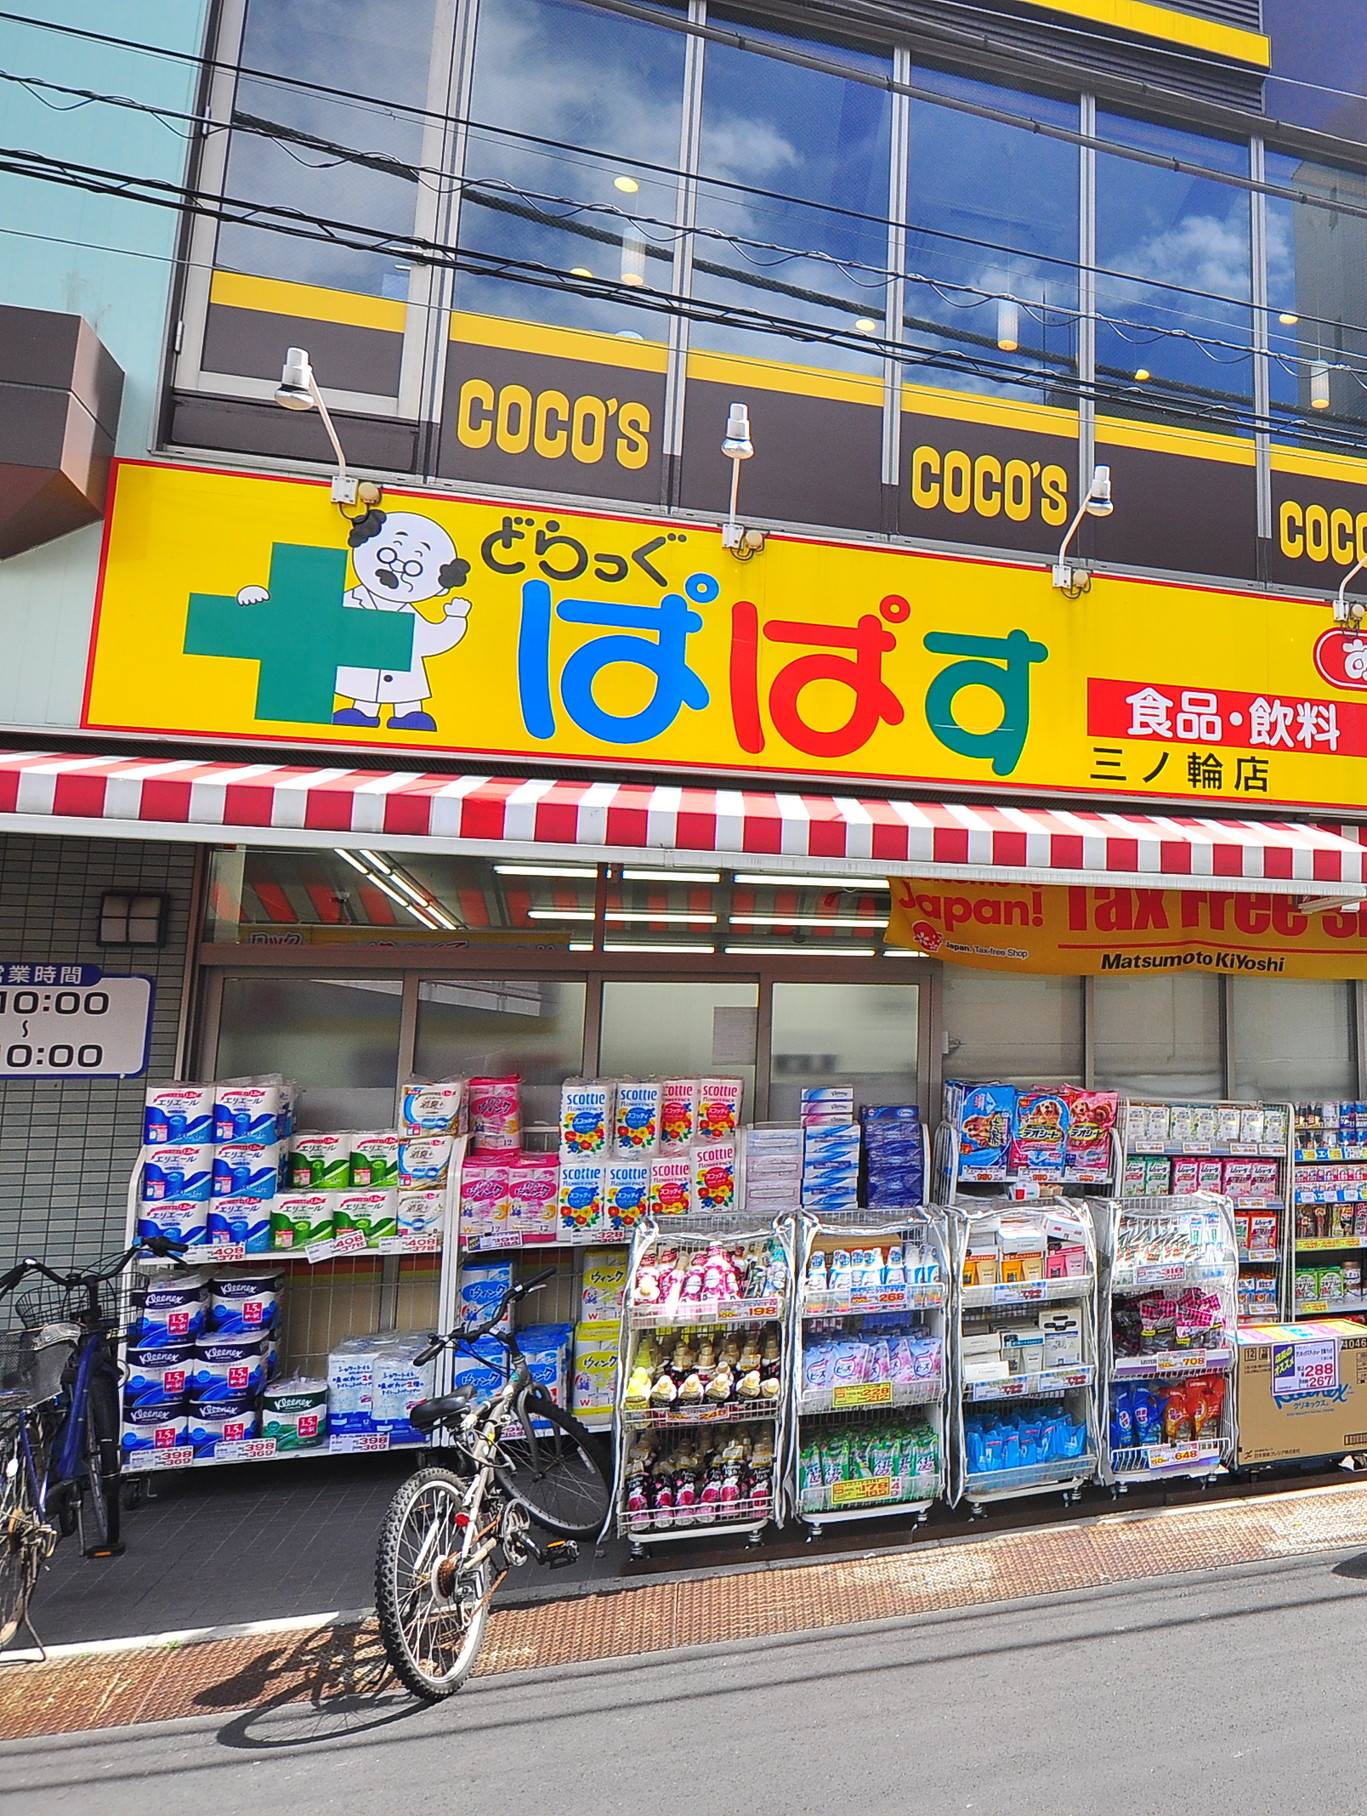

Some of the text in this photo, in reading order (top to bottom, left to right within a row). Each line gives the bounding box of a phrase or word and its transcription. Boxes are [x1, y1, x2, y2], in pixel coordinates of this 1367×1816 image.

[457, 379, 650, 469] COCO'S
[912, 446, 1067, 526] COCO'S
[481, 517, 687, 587] どらっぐ
[518, 573, 1049, 776] ぱぱす
[1125, 687, 1340, 752] 食品・飲料
[1090, 747, 1270, 792] 三ノ輪店
[898, 880, 1044, 932] Japan!
[0, 965, 83, 984] 業時間
[621, 1089, 658, 1101] scottie
[703, 1085, 738, 1097] scottie
[567, 1093, 606, 1105] scottie
[697, 1148, 733, 1162] scottie
[562, 1168, 600, 1180] scottie
[610, 1168, 648, 1180] scottie
[653, 1164, 689, 1176] scottie
[220, 1284, 258, 1295] Kleenex
[145, 1293, 184, 1306] Kleenex
[879, 1293, 905, 1302] 268
[749, 1307, 777, 1316] 198
[139, 1352, 179, 1365] Kleenex
[205, 1347, 243, 1360] Kleenex
[1246, 1349, 1255, 1359] 12
[1183, 1357, 1205, 1366] 708
[1305, 1364, 1334, 1377] 288
[1309, 1376, 1333, 1388] 267
[200, 1405, 239, 1418] Kleenex
[274, 1398, 312, 1413] Kleenex
[130, 1410, 170, 1421] Kleenex
[1175, 1450, 1198, 1460] 648
